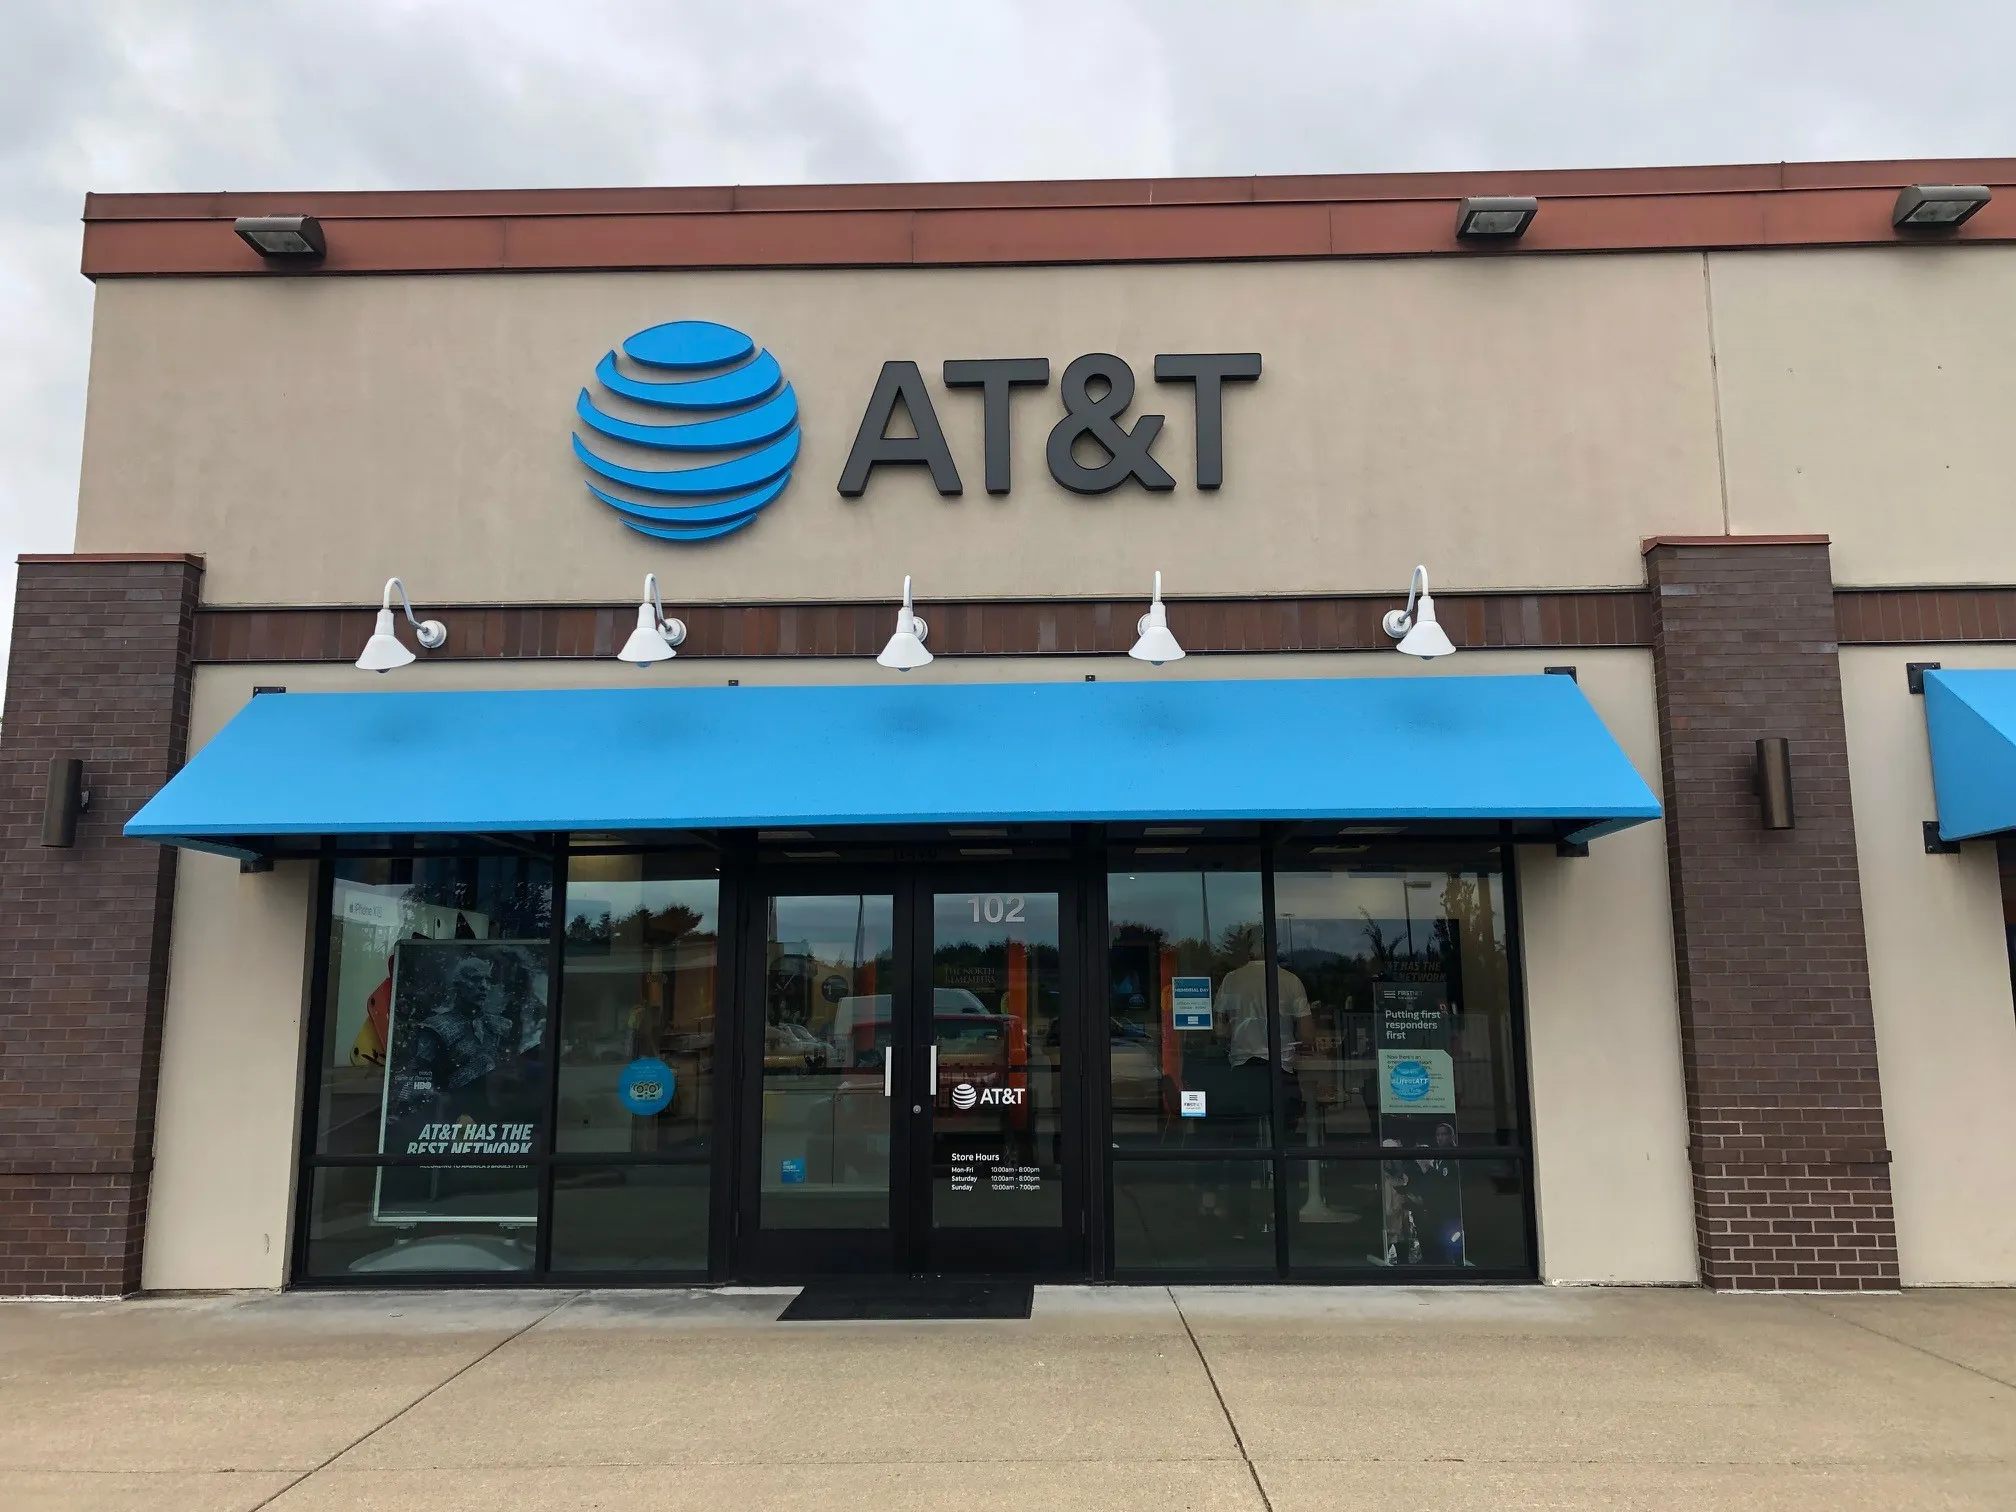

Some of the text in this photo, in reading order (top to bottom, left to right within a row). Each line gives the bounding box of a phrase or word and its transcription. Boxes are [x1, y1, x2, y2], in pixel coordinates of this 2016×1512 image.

[837, 352, 1263, 498] AT&T
[967, 895, 1025, 923] 102
[963, 967, 995, 975] NORTH
[1385, 1010, 1441, 1020] Putting first
[1385, 1020, 1438, 1031] responders
[1386, 1030, 1406, 1040] first
[413, 1082, 432, 1090] HBO
[980, 1088, 1025, 1105] AT&T
[418, 1124, 534, 1140] AT&T HAS THE
[951, 1153, 1000, 1161] Store Hours
[951, 1175, 978, 1183] Saturday
[951, 1184, 974, 1192] Sunday
[1019, 1184, 1040, 1192] 7:00pm
